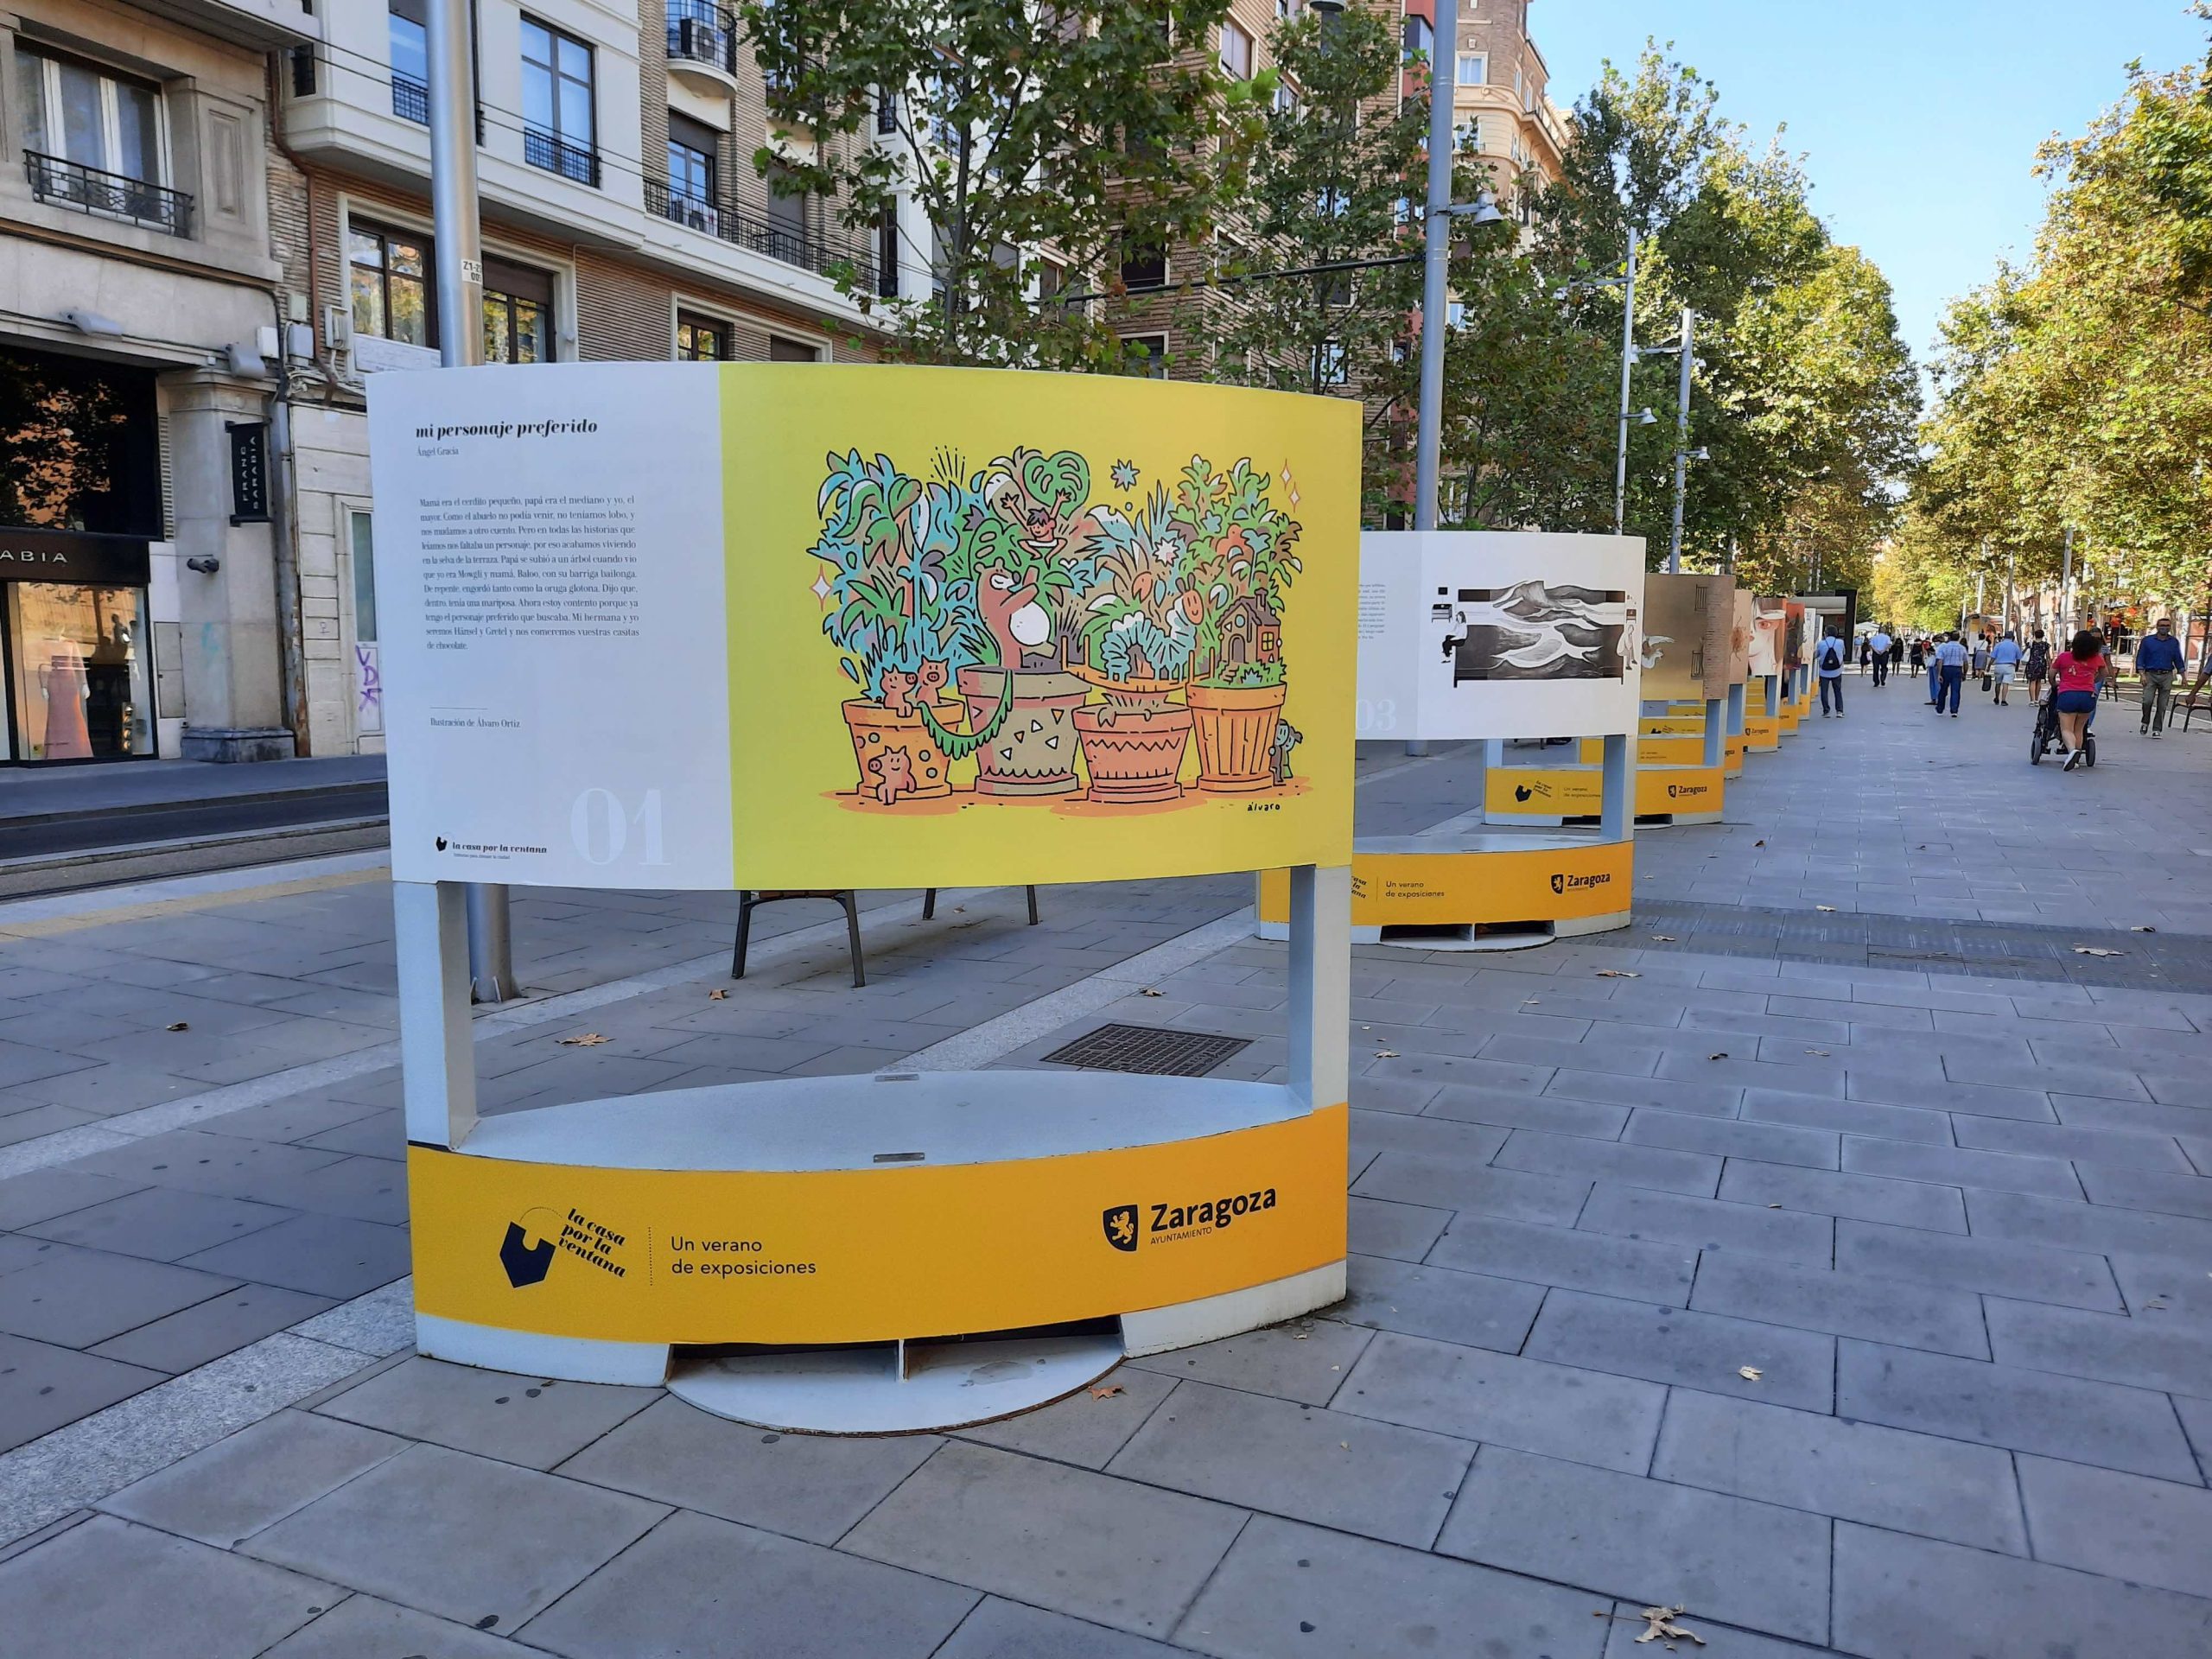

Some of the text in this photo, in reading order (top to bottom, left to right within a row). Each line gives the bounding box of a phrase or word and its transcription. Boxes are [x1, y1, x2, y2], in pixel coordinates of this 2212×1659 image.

[416, 419, 597, 441] mi personaje preferido
[416, 446, 459, 457] Ángel Gracia
[525, 497, 543, 507] papá
[614, 498, 625, 506] yo,
[510, 512, 531, 522] podía
[608, 511, 628, 520] lobo,
[474, 526, 489, 535] otro
[584, 525, 618, 534] historias
[620, 527, 635, 536] que
[534, 543, 546, 551] por
[562, 540, 601, 549] acabamos
[501, 556, 518, 566] Papá
[530, 555, 550, 563] subió
[423, 572, 436, 581] que
[458, 570, 482, 581] Mowgli
[518, 569, 541, 579] Baloo,
[569, 569, 598, 580] barriga
[462, 584, 491, 594] engordó
[544, 586, 567, 594] oruga
[602, 584, 619, 594] Dijo
[620, 586, 638, 594] que,
[543, 599, 561, 609] estoy
[599, 601, 627, 609] porque
[425, 613, 443, 623] tengo
[452, 613, 484, 623] personaje
[486, 613, 519, 623] preferido
[521, 614, 535, 623] que
[430, 716, 520, 728] Ilustración de Álvaro Ortiz
[1248, 801, 1280, 811] álvaro
[570, 787, 671, 865] 01
[483, 844, 498, 853] por
[1567, 874, 1610, 888] Zaragoza
[1151, 1188, 1276, 1232] Zaragoza
[568, 1208, 625, 1246] la casa
[561, 1224, 612, 1255] por la
[1150, 1227, 1212, 1244] AYUNTAMIENTO
[671, 1236, 762, 1252] Un verano
[558, 1237, 626, 1277] ventana
[671, 1259, 817, 1279] de exposiciones
